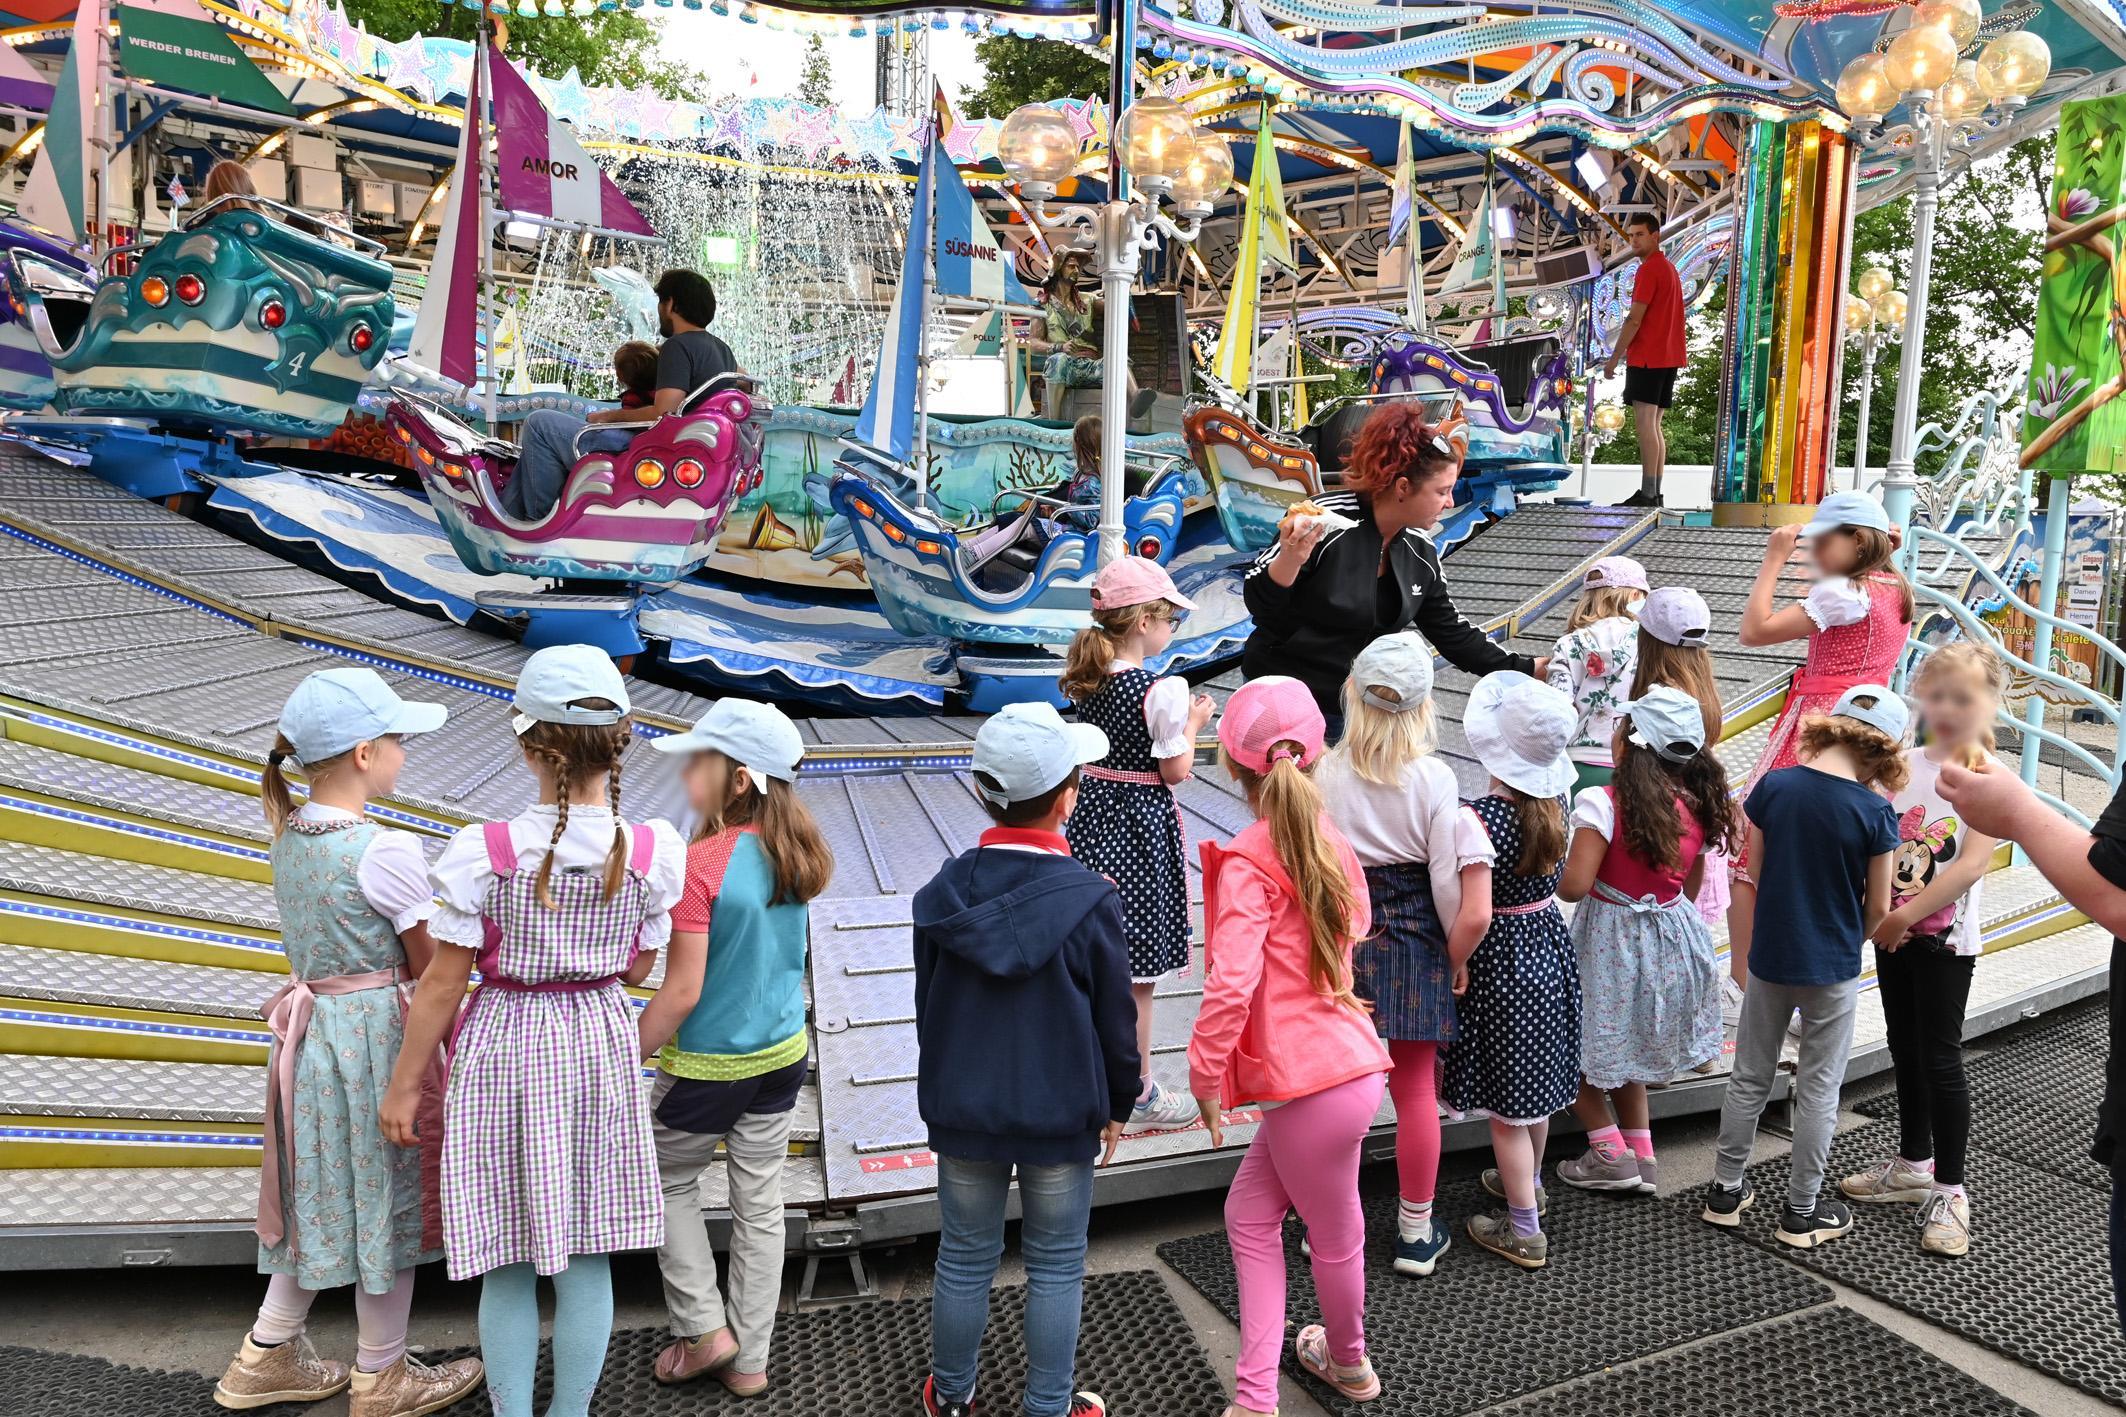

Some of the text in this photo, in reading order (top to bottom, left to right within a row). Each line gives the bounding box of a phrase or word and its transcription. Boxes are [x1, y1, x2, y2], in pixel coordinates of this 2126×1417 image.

[128, 36, 236, 66] WERDER BREMEN
[521, 155, 578, 181] AMOR
[944, 236, 997, 262] SÜSANNE
[973, 334, 996, 342] POLLY
[288, 351, 306, 377] 4
[2082, 554, 2103, 565] Eingang
[2074, 588, 2097, 596] Damen
[2069, 612, 2094, 621] Herren
